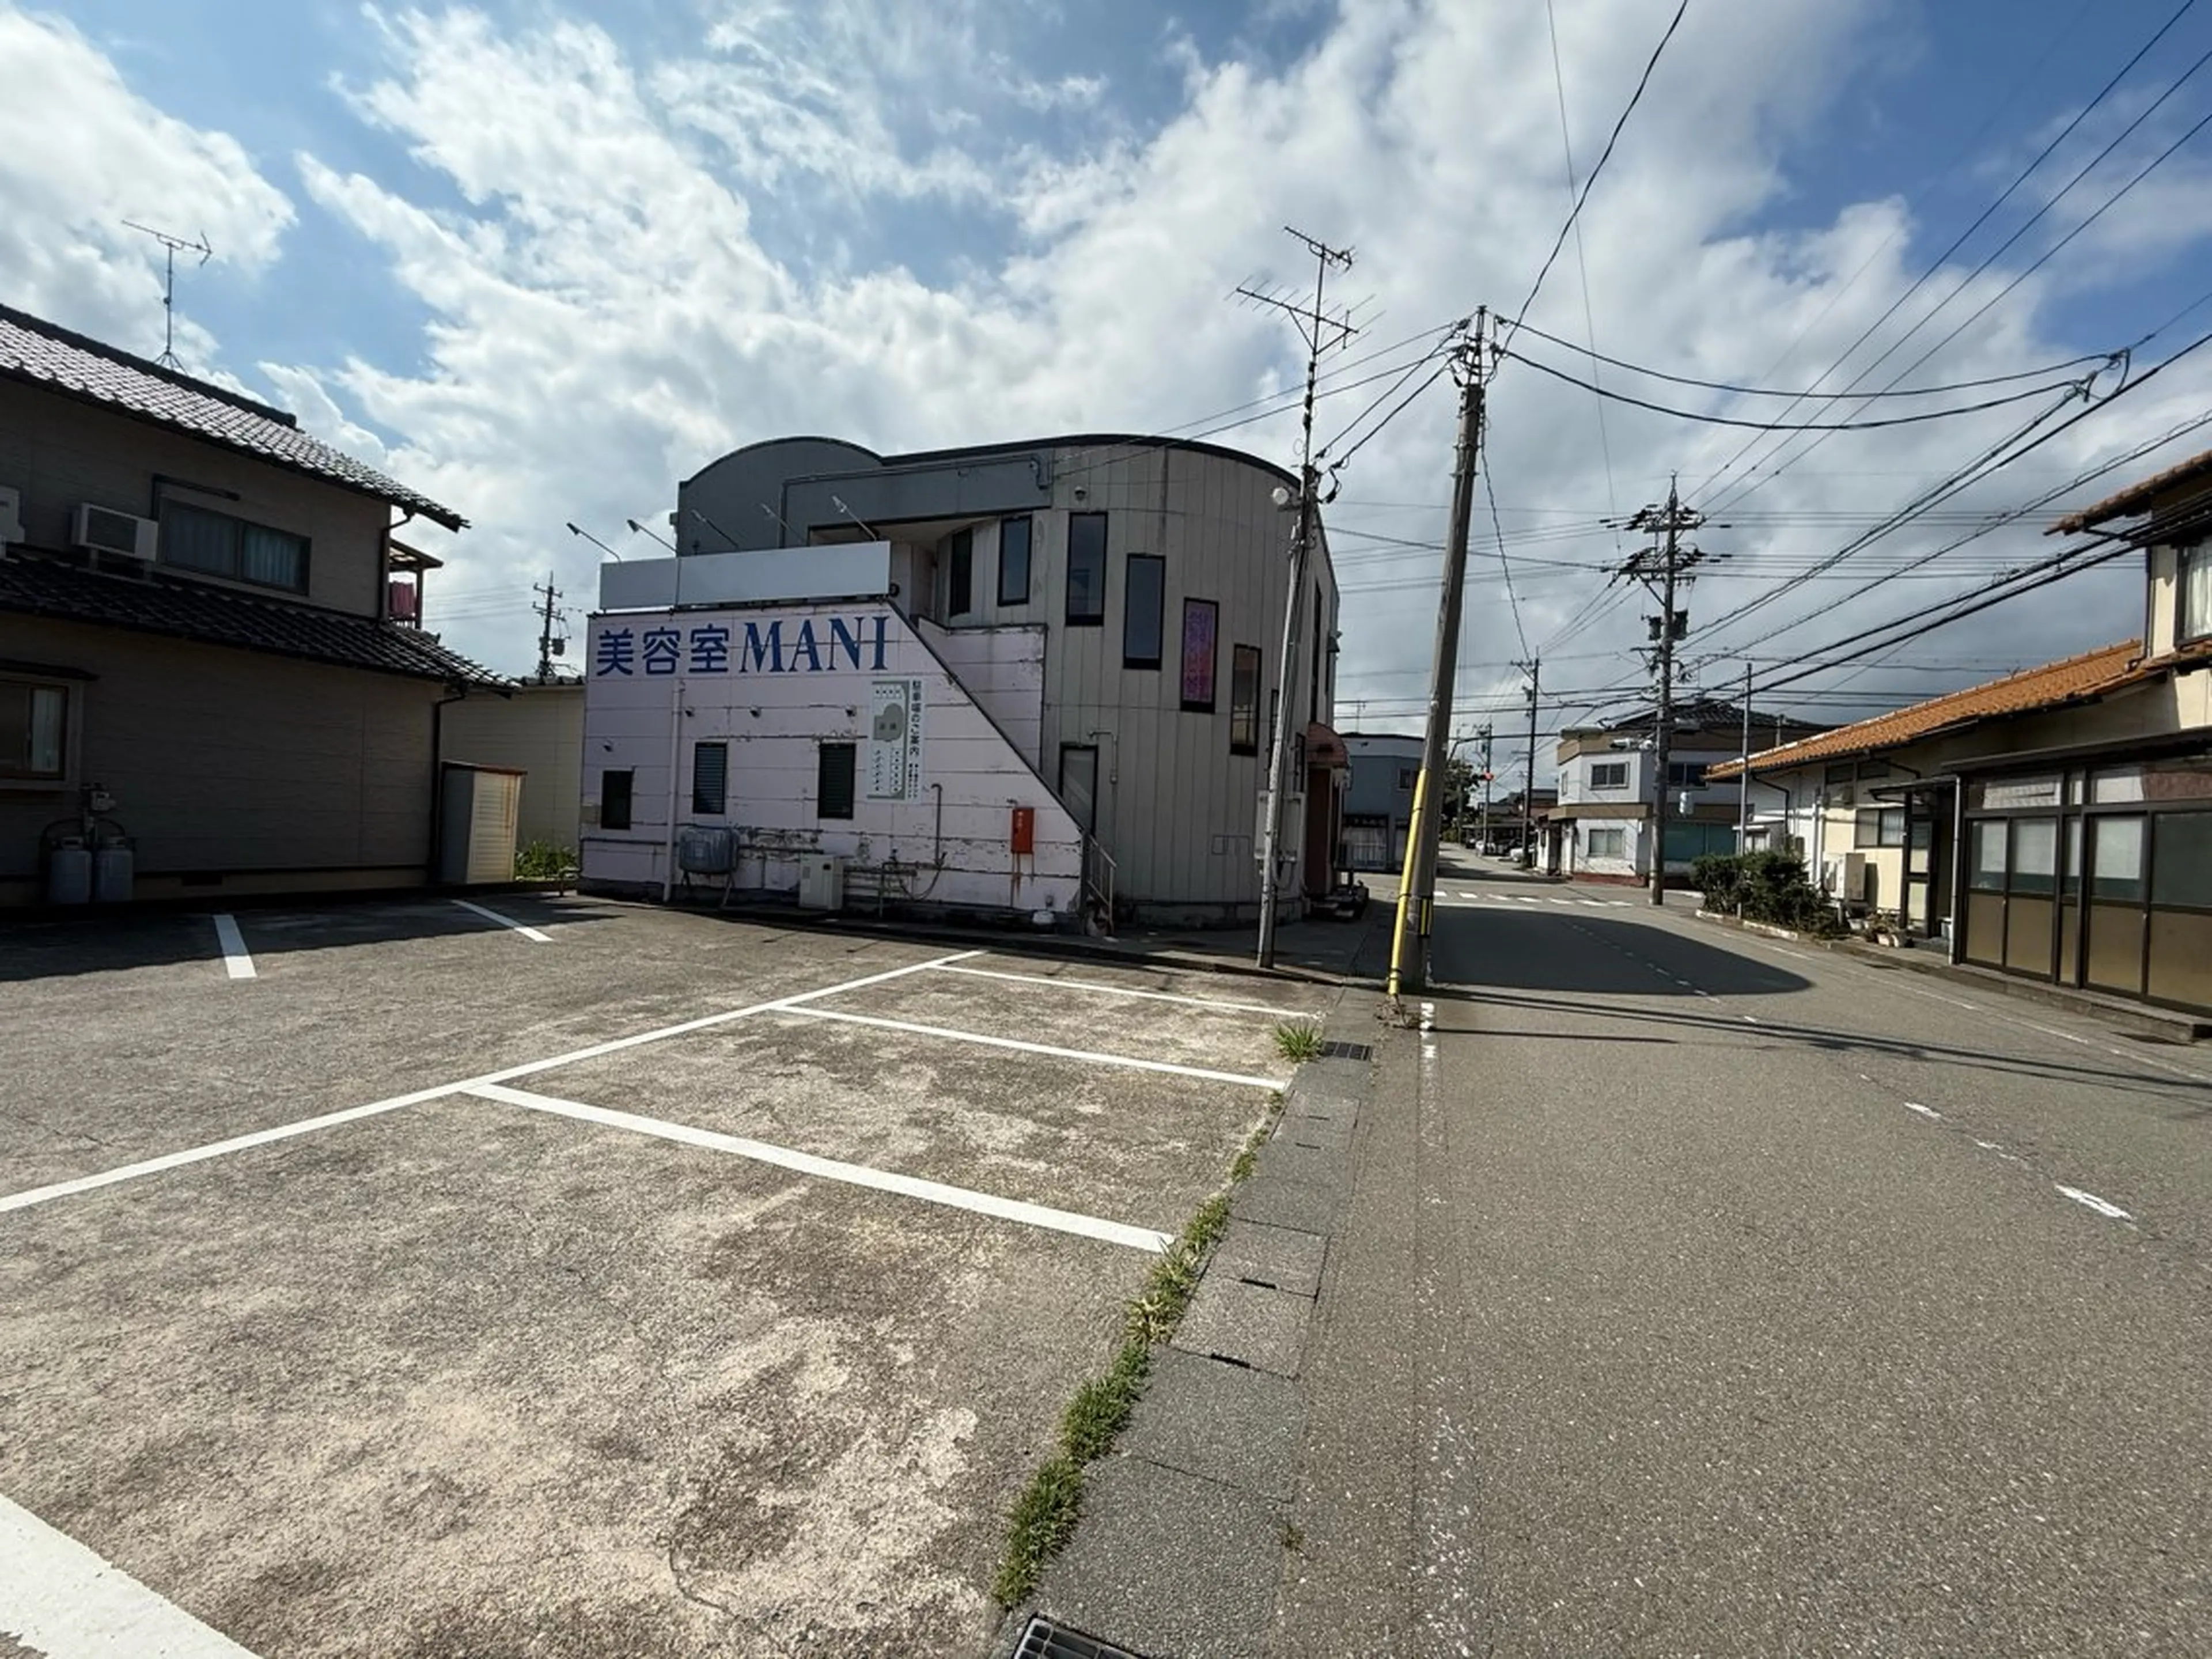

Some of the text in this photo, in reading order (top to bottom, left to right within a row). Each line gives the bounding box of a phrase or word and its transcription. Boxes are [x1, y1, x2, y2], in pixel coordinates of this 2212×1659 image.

[596, 616, 890, 677] 美容室 MANI
